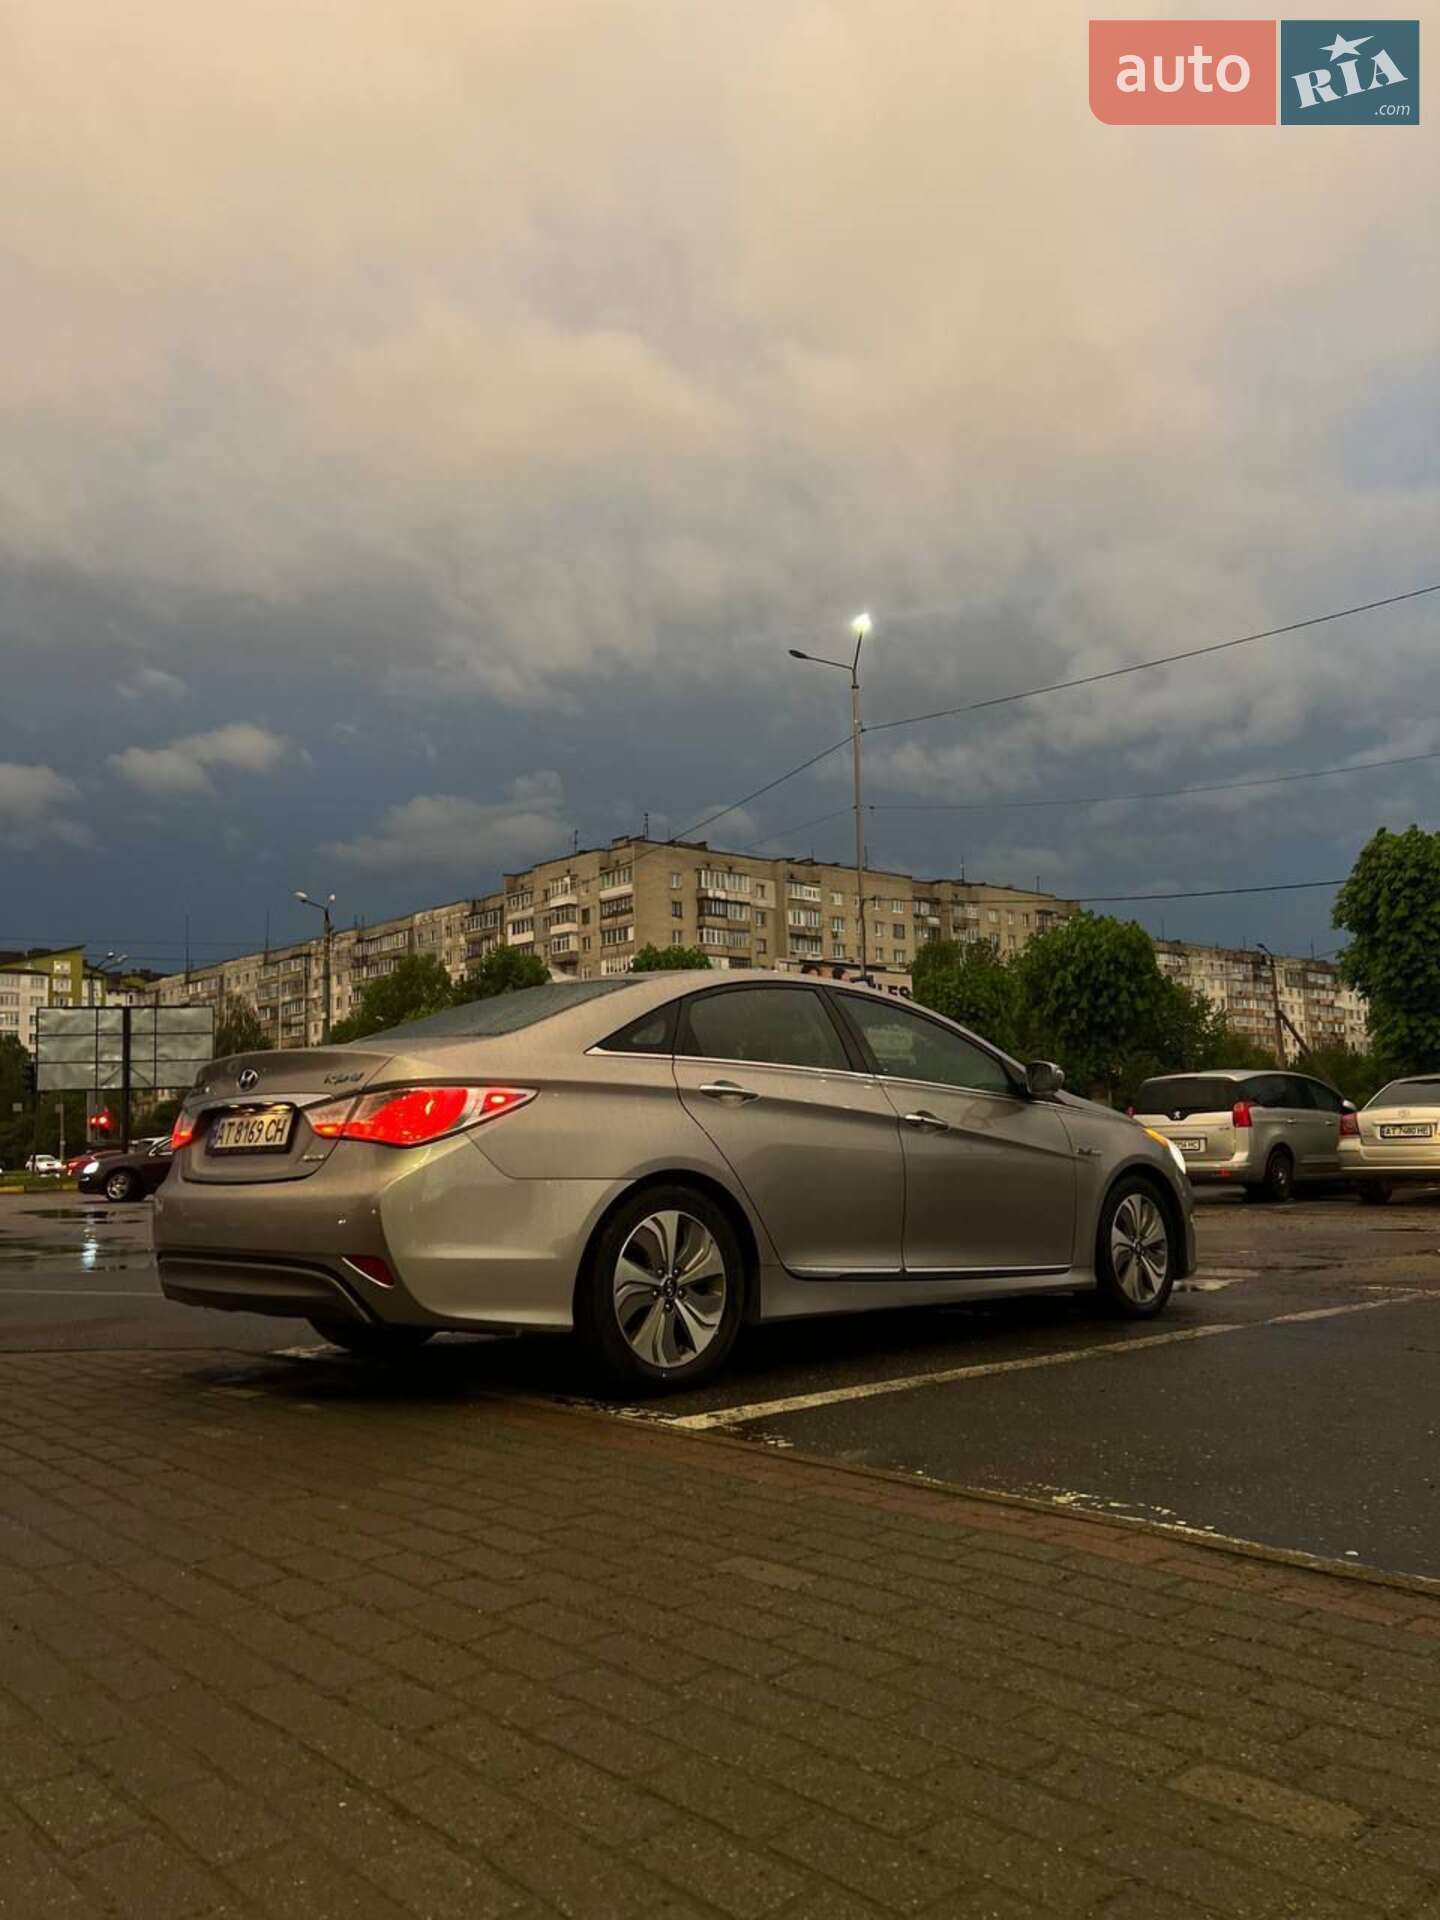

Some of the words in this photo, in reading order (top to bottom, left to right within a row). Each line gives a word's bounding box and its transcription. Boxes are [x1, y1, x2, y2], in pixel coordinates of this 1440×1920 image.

[215, 1121, 236, 1145] AT
[234, 1119, 265, 1144] 8169
[265, 1118, 288, 1142] CH
